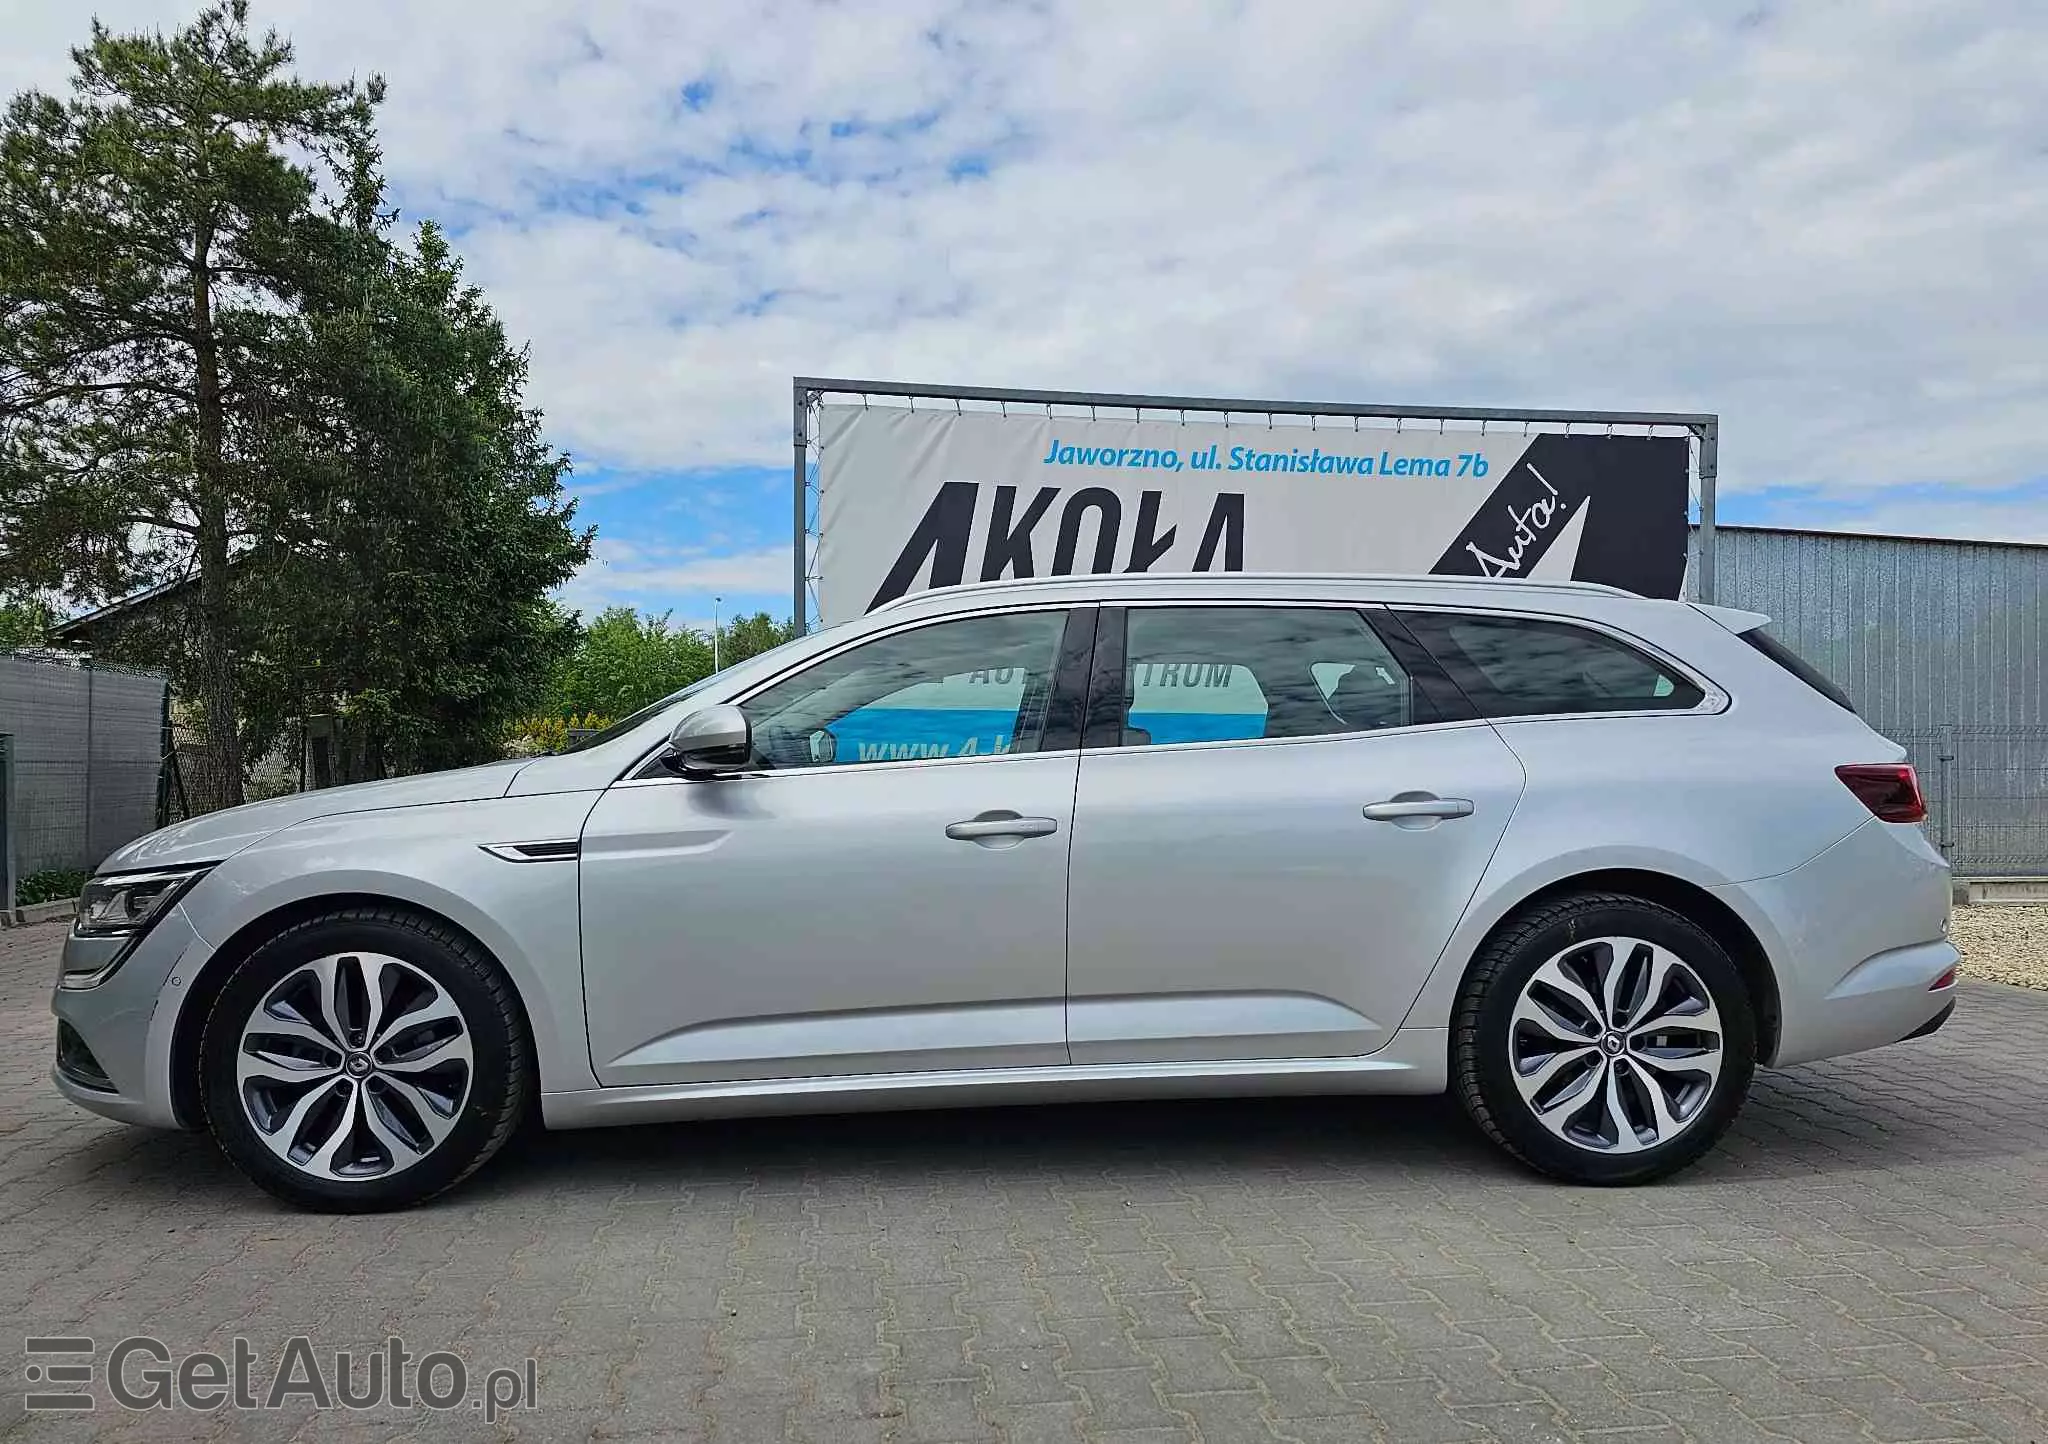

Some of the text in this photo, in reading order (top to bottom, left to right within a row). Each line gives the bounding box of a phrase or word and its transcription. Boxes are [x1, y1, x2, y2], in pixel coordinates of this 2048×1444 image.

[1043, 439, 1490, 478] Jaworzno, ul. Stanisława Lema 7b
[1466, 462, 1567, 578] Auta!
